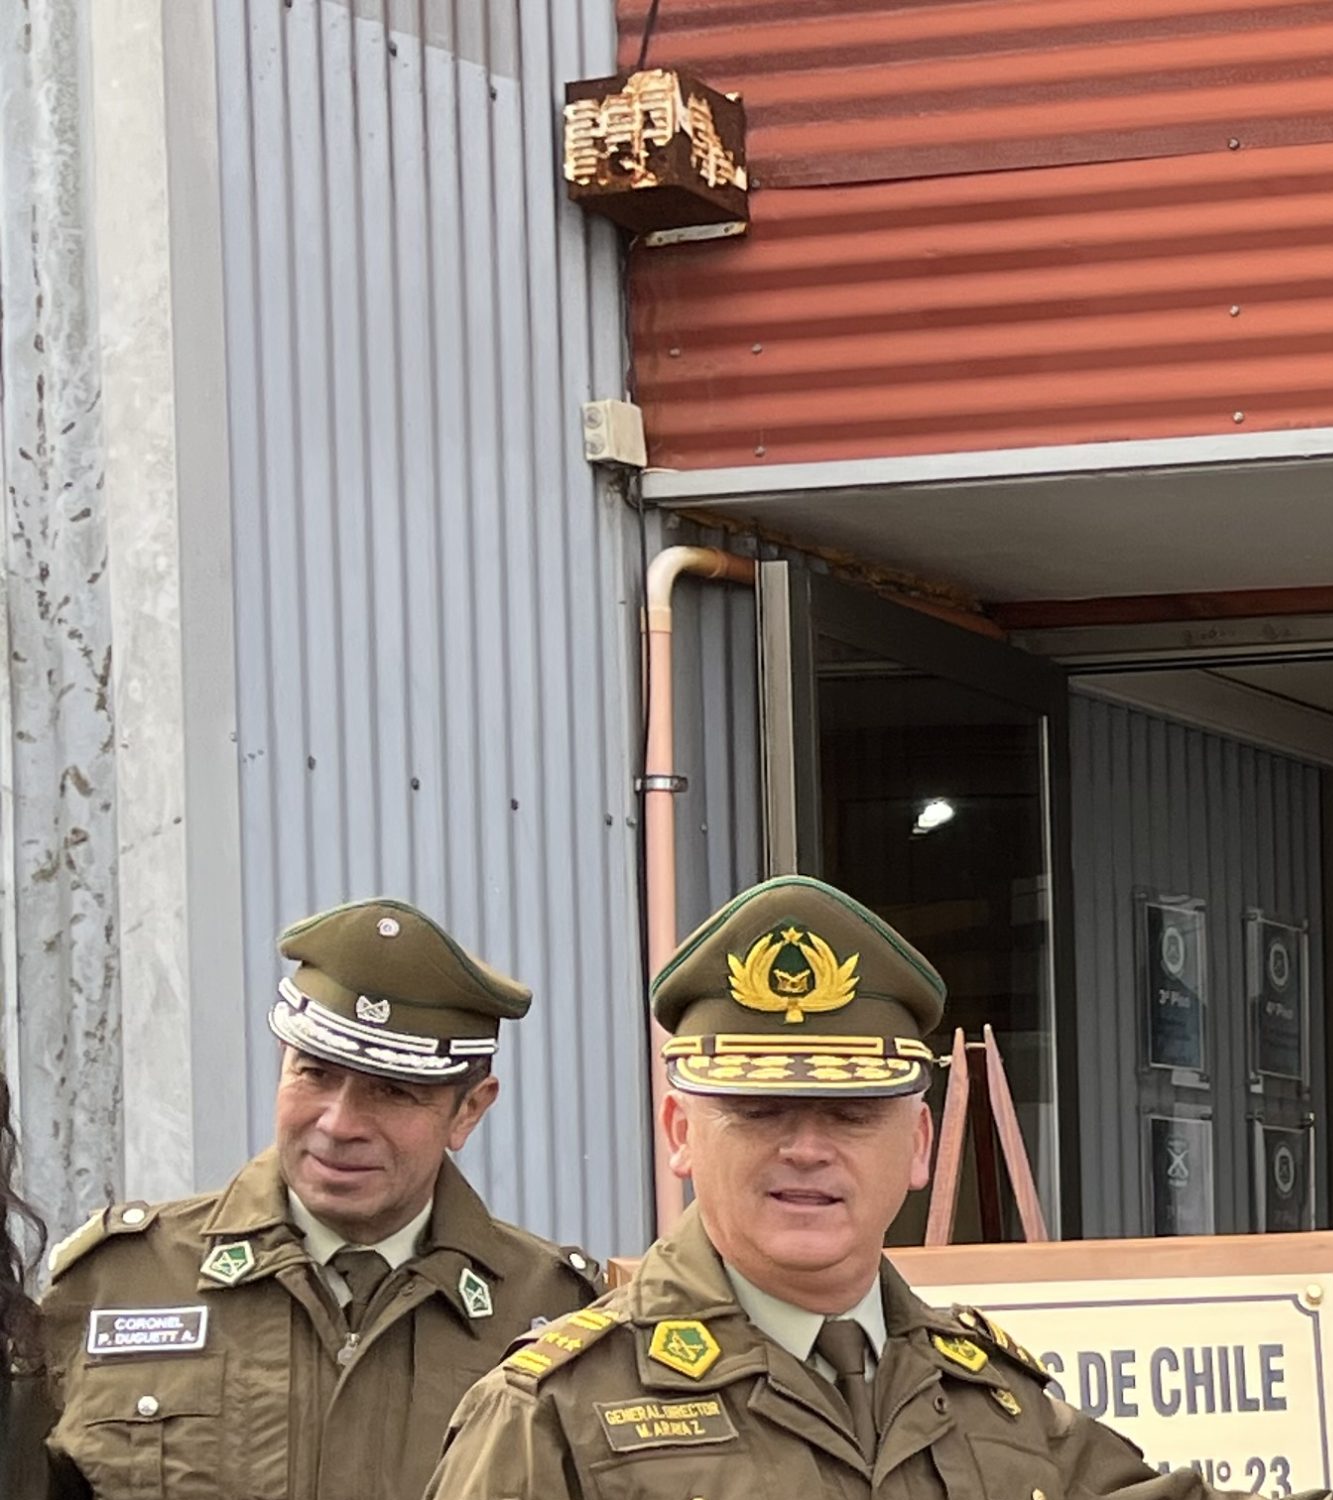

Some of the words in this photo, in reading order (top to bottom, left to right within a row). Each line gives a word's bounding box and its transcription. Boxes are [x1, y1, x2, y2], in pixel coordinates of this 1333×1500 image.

[114, 1317, 184, 1330] CORONEL
[1077, 1350, 1139, 1418] DE
[1151, 1344, 1287, 1417] CHILE
[605, 1405, 664, 1425] GENERAL
[662, 1402, 720, 1418] DIRECTOR
[1245, 1456, 1292, 1500] 23
